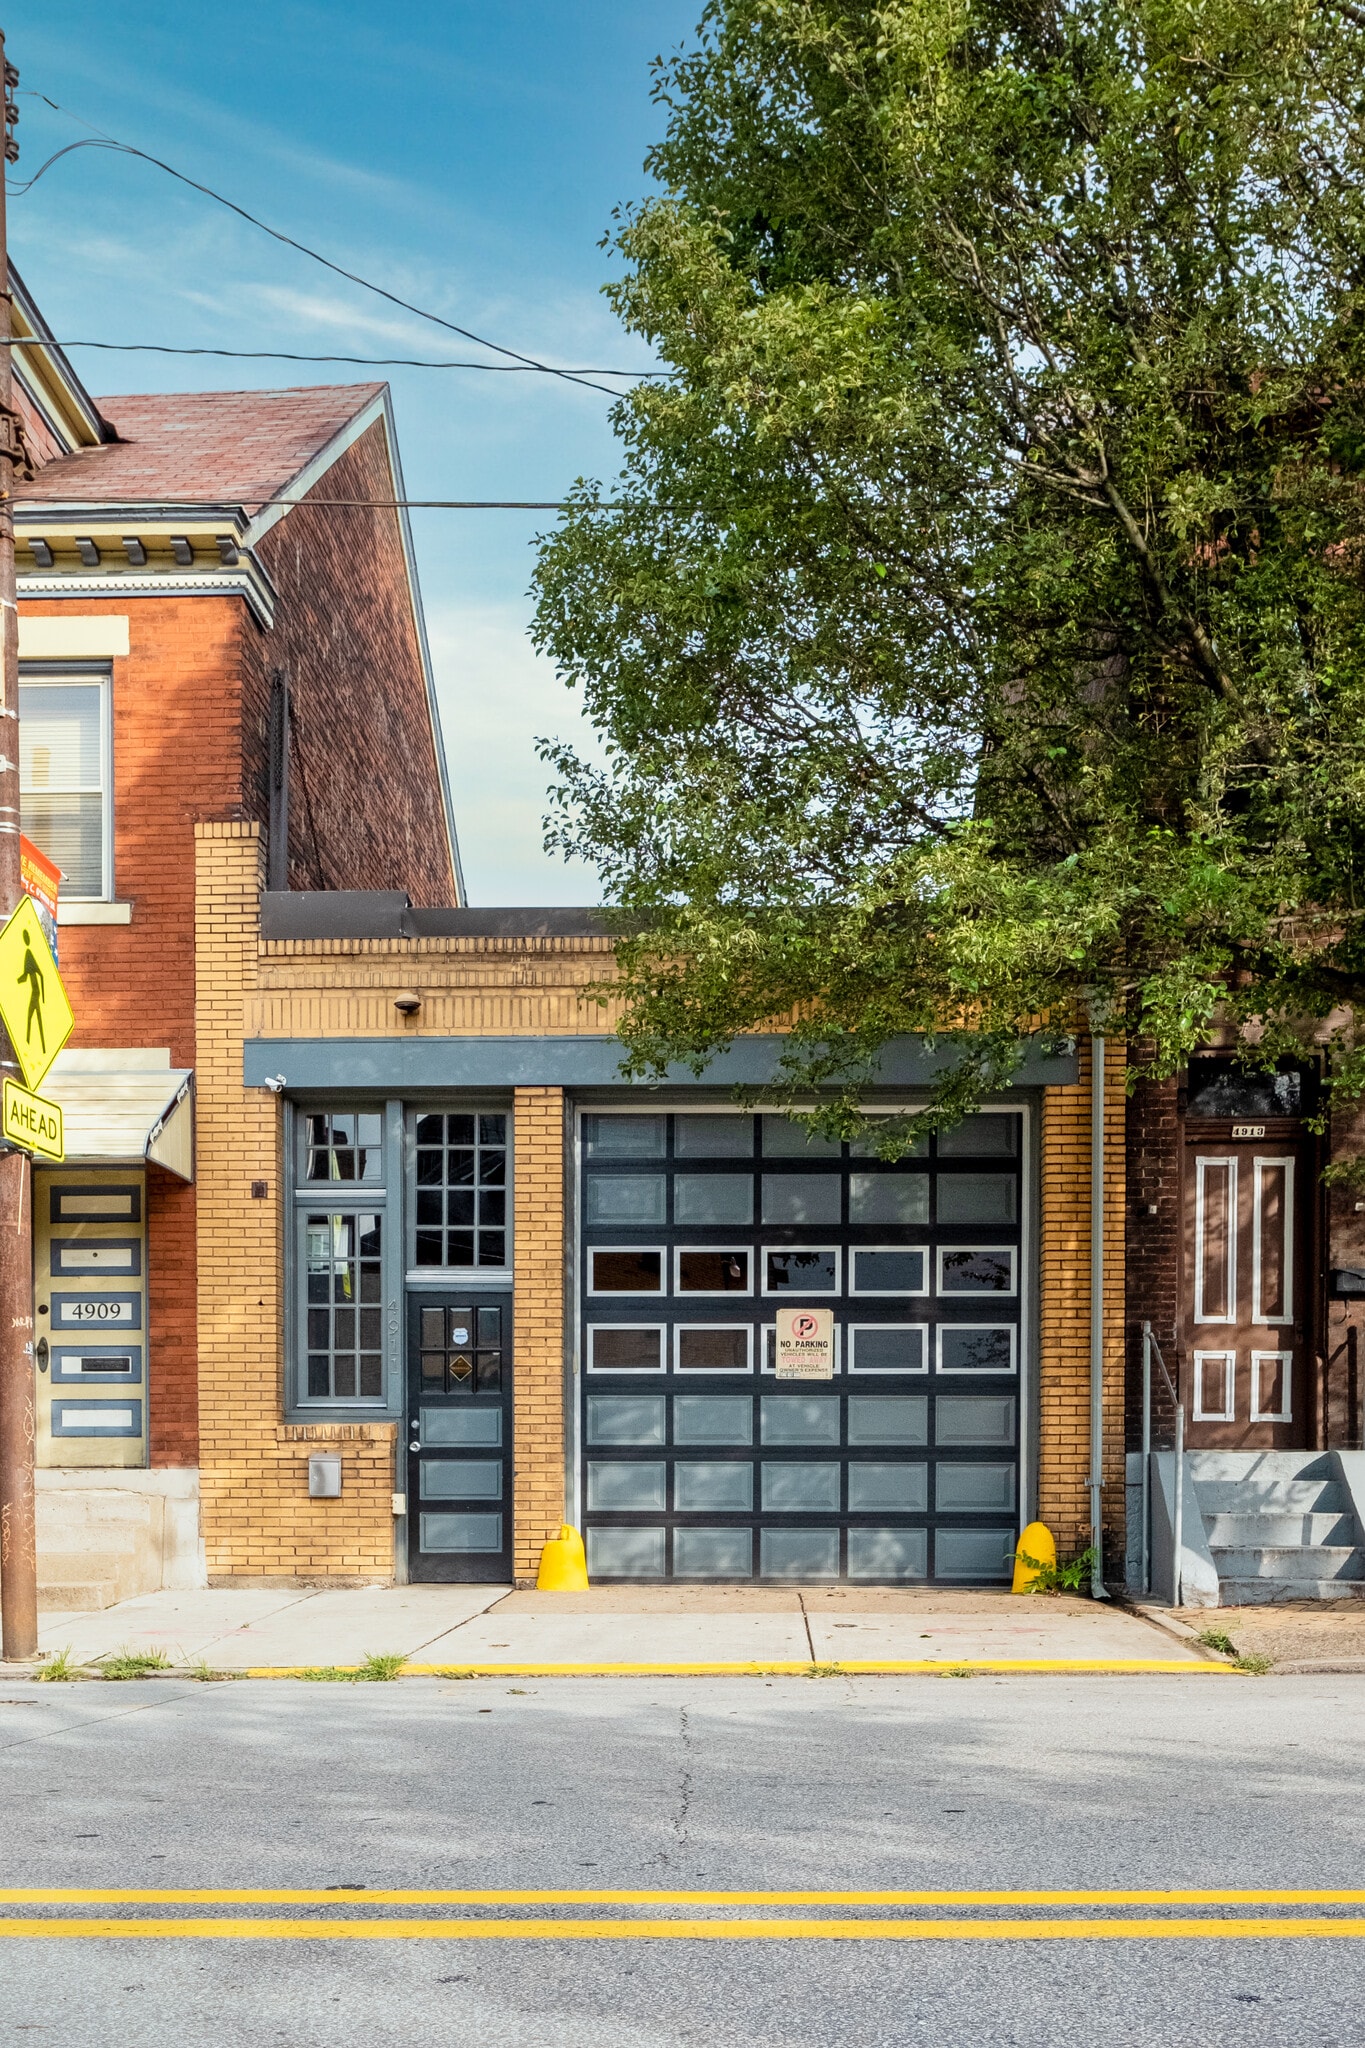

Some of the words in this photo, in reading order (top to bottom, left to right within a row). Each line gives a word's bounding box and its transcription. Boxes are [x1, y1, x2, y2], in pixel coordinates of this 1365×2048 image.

[11, 1100, 57, 1140] AHEAD
[1232, 1127, 1264, 1136] 4913
[72, 1303, 121, 1319] 4909
[387, 1299, 399, 1375] 4911
